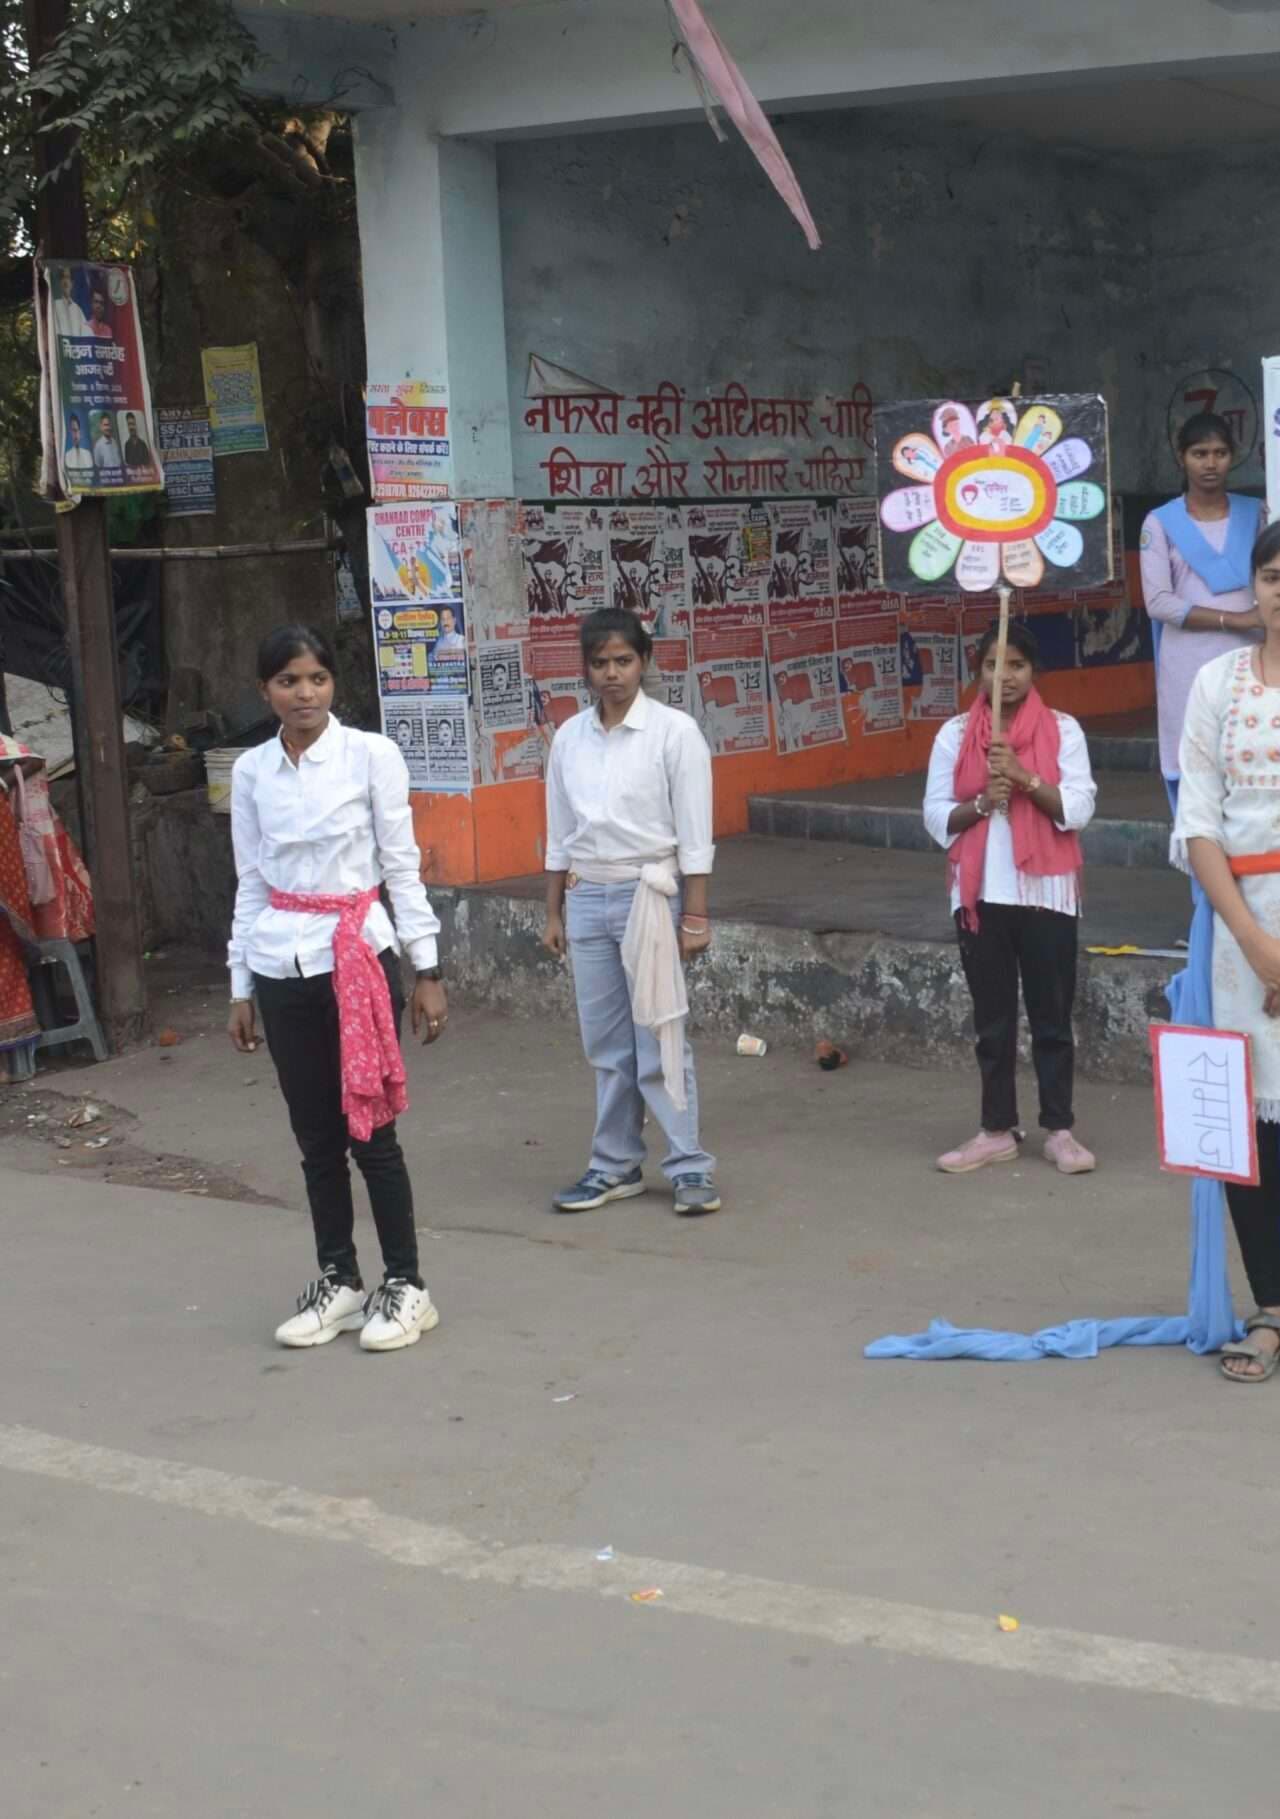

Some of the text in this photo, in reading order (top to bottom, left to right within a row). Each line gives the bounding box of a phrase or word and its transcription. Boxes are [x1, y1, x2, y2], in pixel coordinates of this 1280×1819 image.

[626, 381, 688, 444] नहीं
[691, 382, 814, 438] अधिकार
[820, 382, 876, 449] चाहि
[703, 446, 789, 497] रोजगार
[1187, 1050, 1234, 1169] समाज
